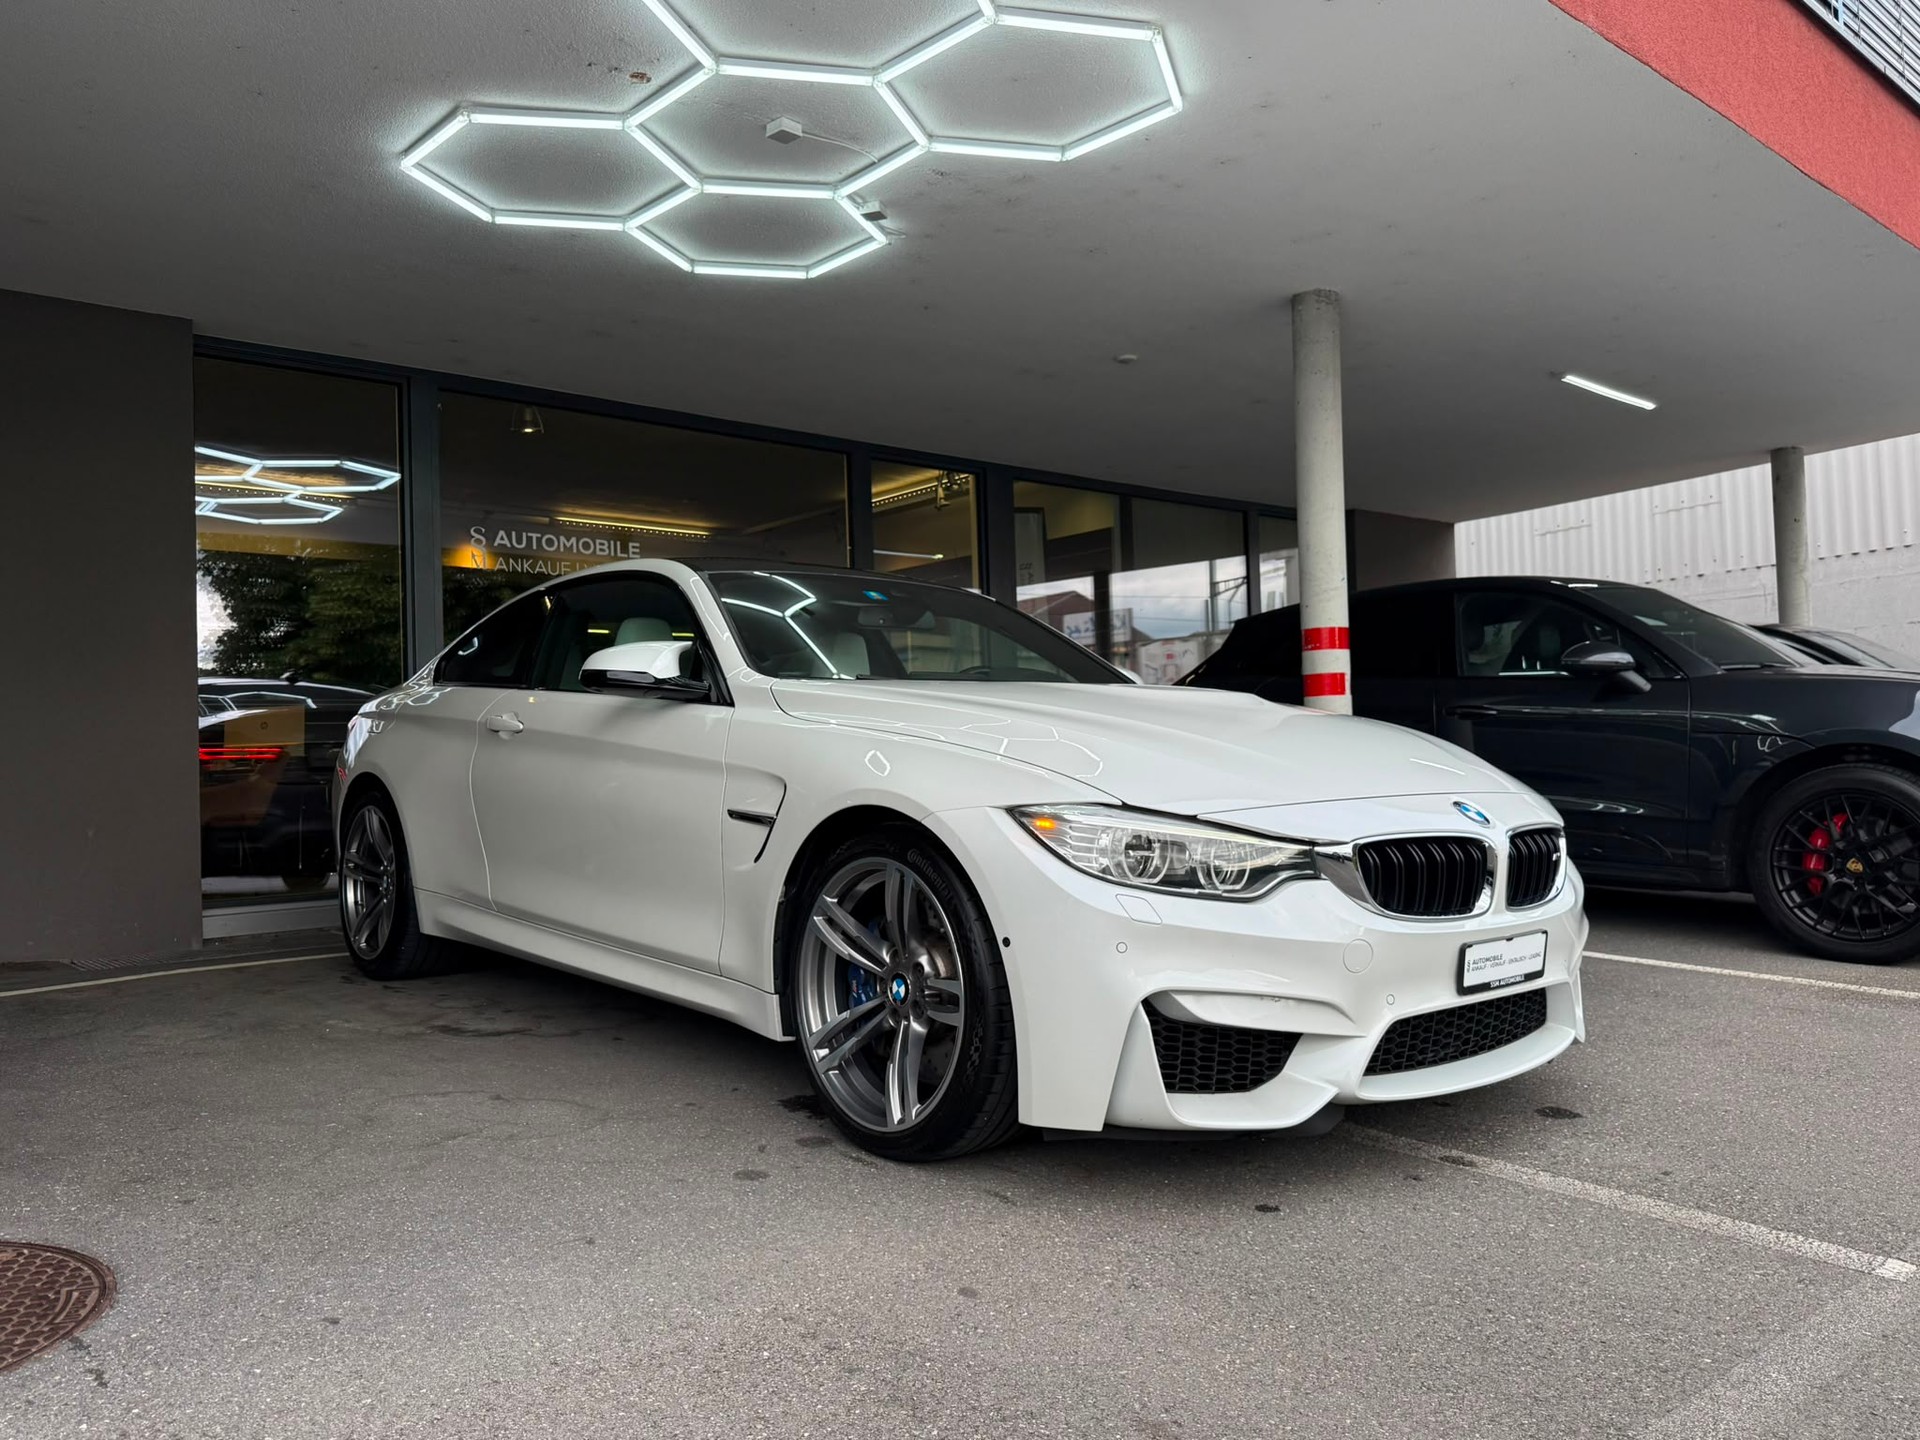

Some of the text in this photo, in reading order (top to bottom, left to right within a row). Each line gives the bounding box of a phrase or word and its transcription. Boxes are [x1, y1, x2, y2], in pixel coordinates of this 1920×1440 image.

[493, 530, 641, 558] AUTOMOBILE
[494, 557, 571, 576] ANKAUF
[1472, 953, 1503, 965] AUTOMOBILE
